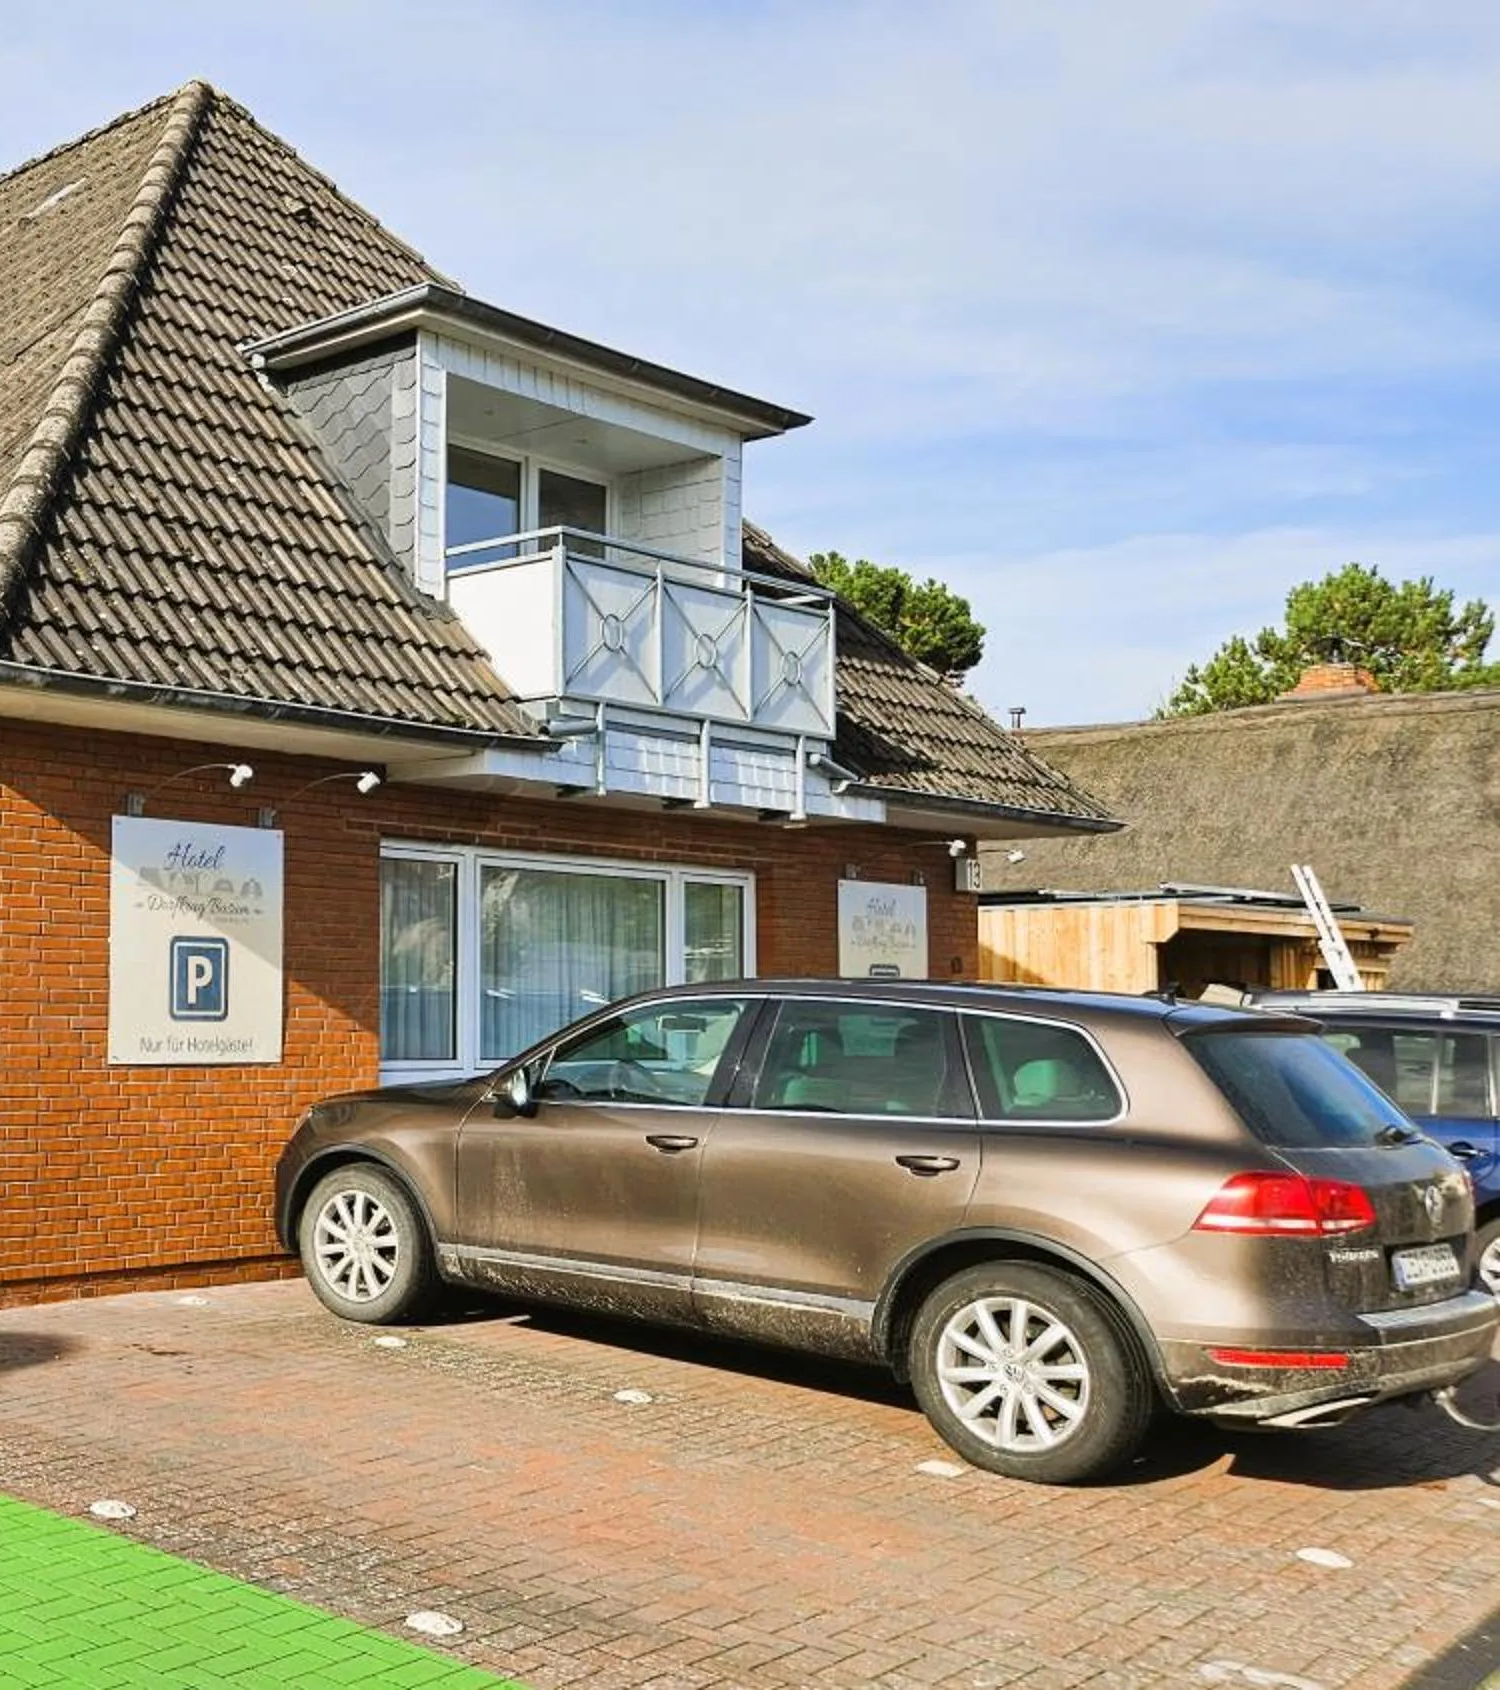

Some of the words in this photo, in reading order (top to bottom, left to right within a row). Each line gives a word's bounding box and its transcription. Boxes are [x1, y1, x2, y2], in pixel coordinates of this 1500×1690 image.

[164, 842, 225, 870] Hotel
[969, 862, 980, 889] 13
[187, 955, 213, 1005] P
[139, 1037, 162, 1053] Nur
[167, 1036, 185, 1053] für
